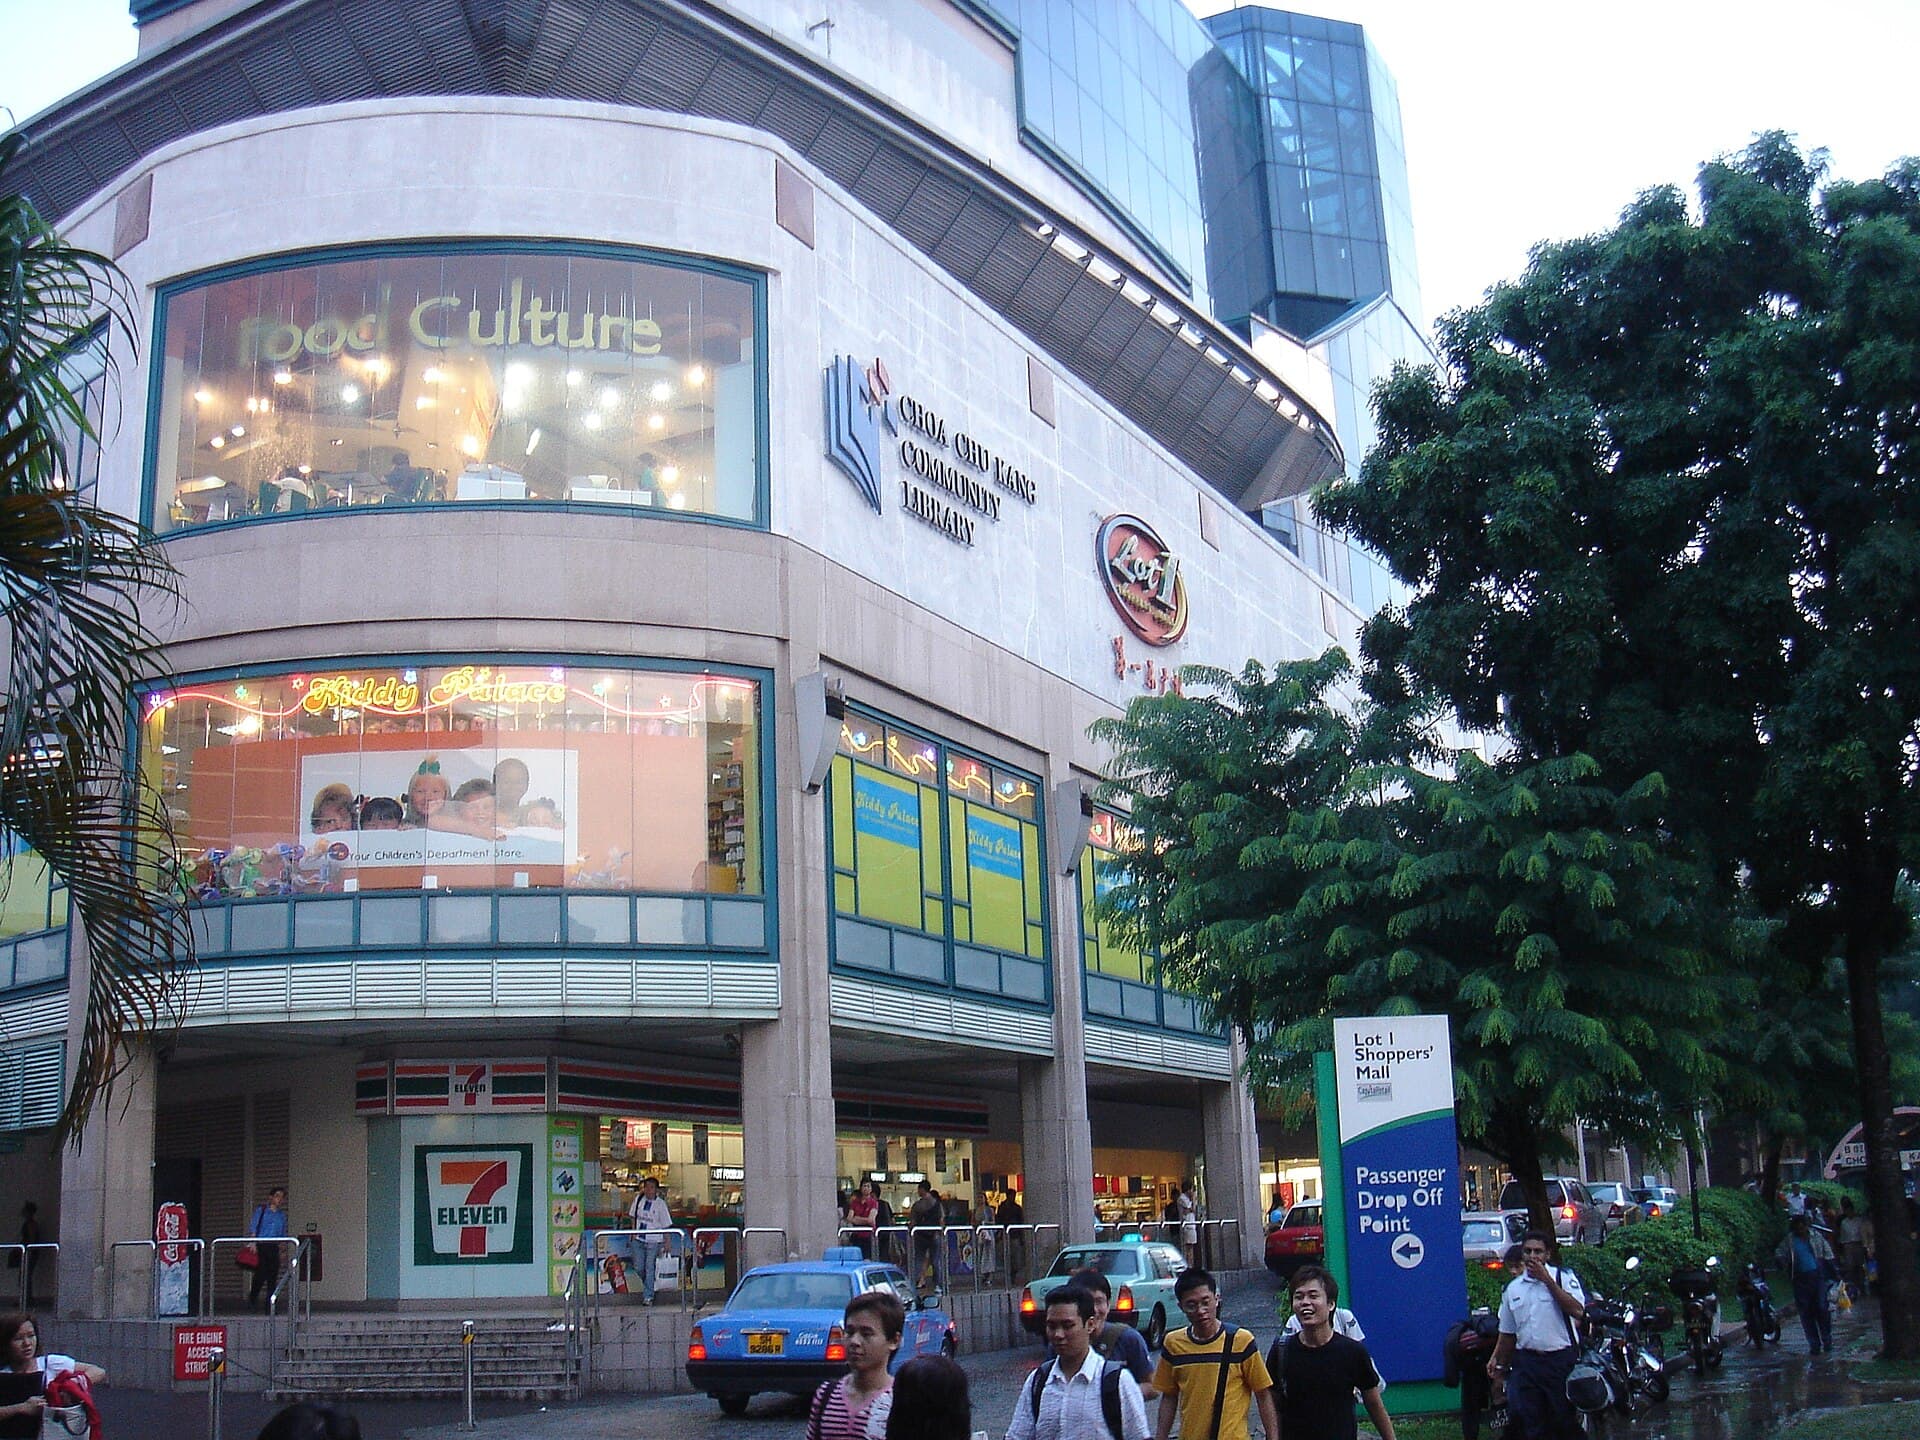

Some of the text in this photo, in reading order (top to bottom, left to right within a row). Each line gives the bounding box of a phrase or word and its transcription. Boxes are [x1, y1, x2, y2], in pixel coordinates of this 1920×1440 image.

[409, 277, 663, 355] Culture
[899, 395, 1036, 506] CHOA CHU KANG
[900, 439, 1000, 521] COMMUNITY
[901, 480, 975, 547] LIBRARY
[1111, 534, 1164, 592] Lot
[303, 666, 566, 713] Kiddy Palace
[350, 852, 371, 862] Your
[375, 849, 423, 861] Children's
[427, 849, 490, 861] Department
[1353, 1032, 1382, 1047] Lot
[1354, 1046, 1434, 1065] Shoppers'
[1356, 1065, 1390, 1081] Mall
[455, 1064, 487, 1106] 7
[1356, 1166, 1446, 1188] Passenger
[440, 1160, 508, 1258] 7
[1358, 1187, 1443, 1212] Drop Off
[1359, 1214, 1410, 1233] Point
[179, 1331, 224, 1344] FIRE ENGINE
[187, 1346, 212, 1359] ACCES
[184, 1361, 210, 1374] STRICT
